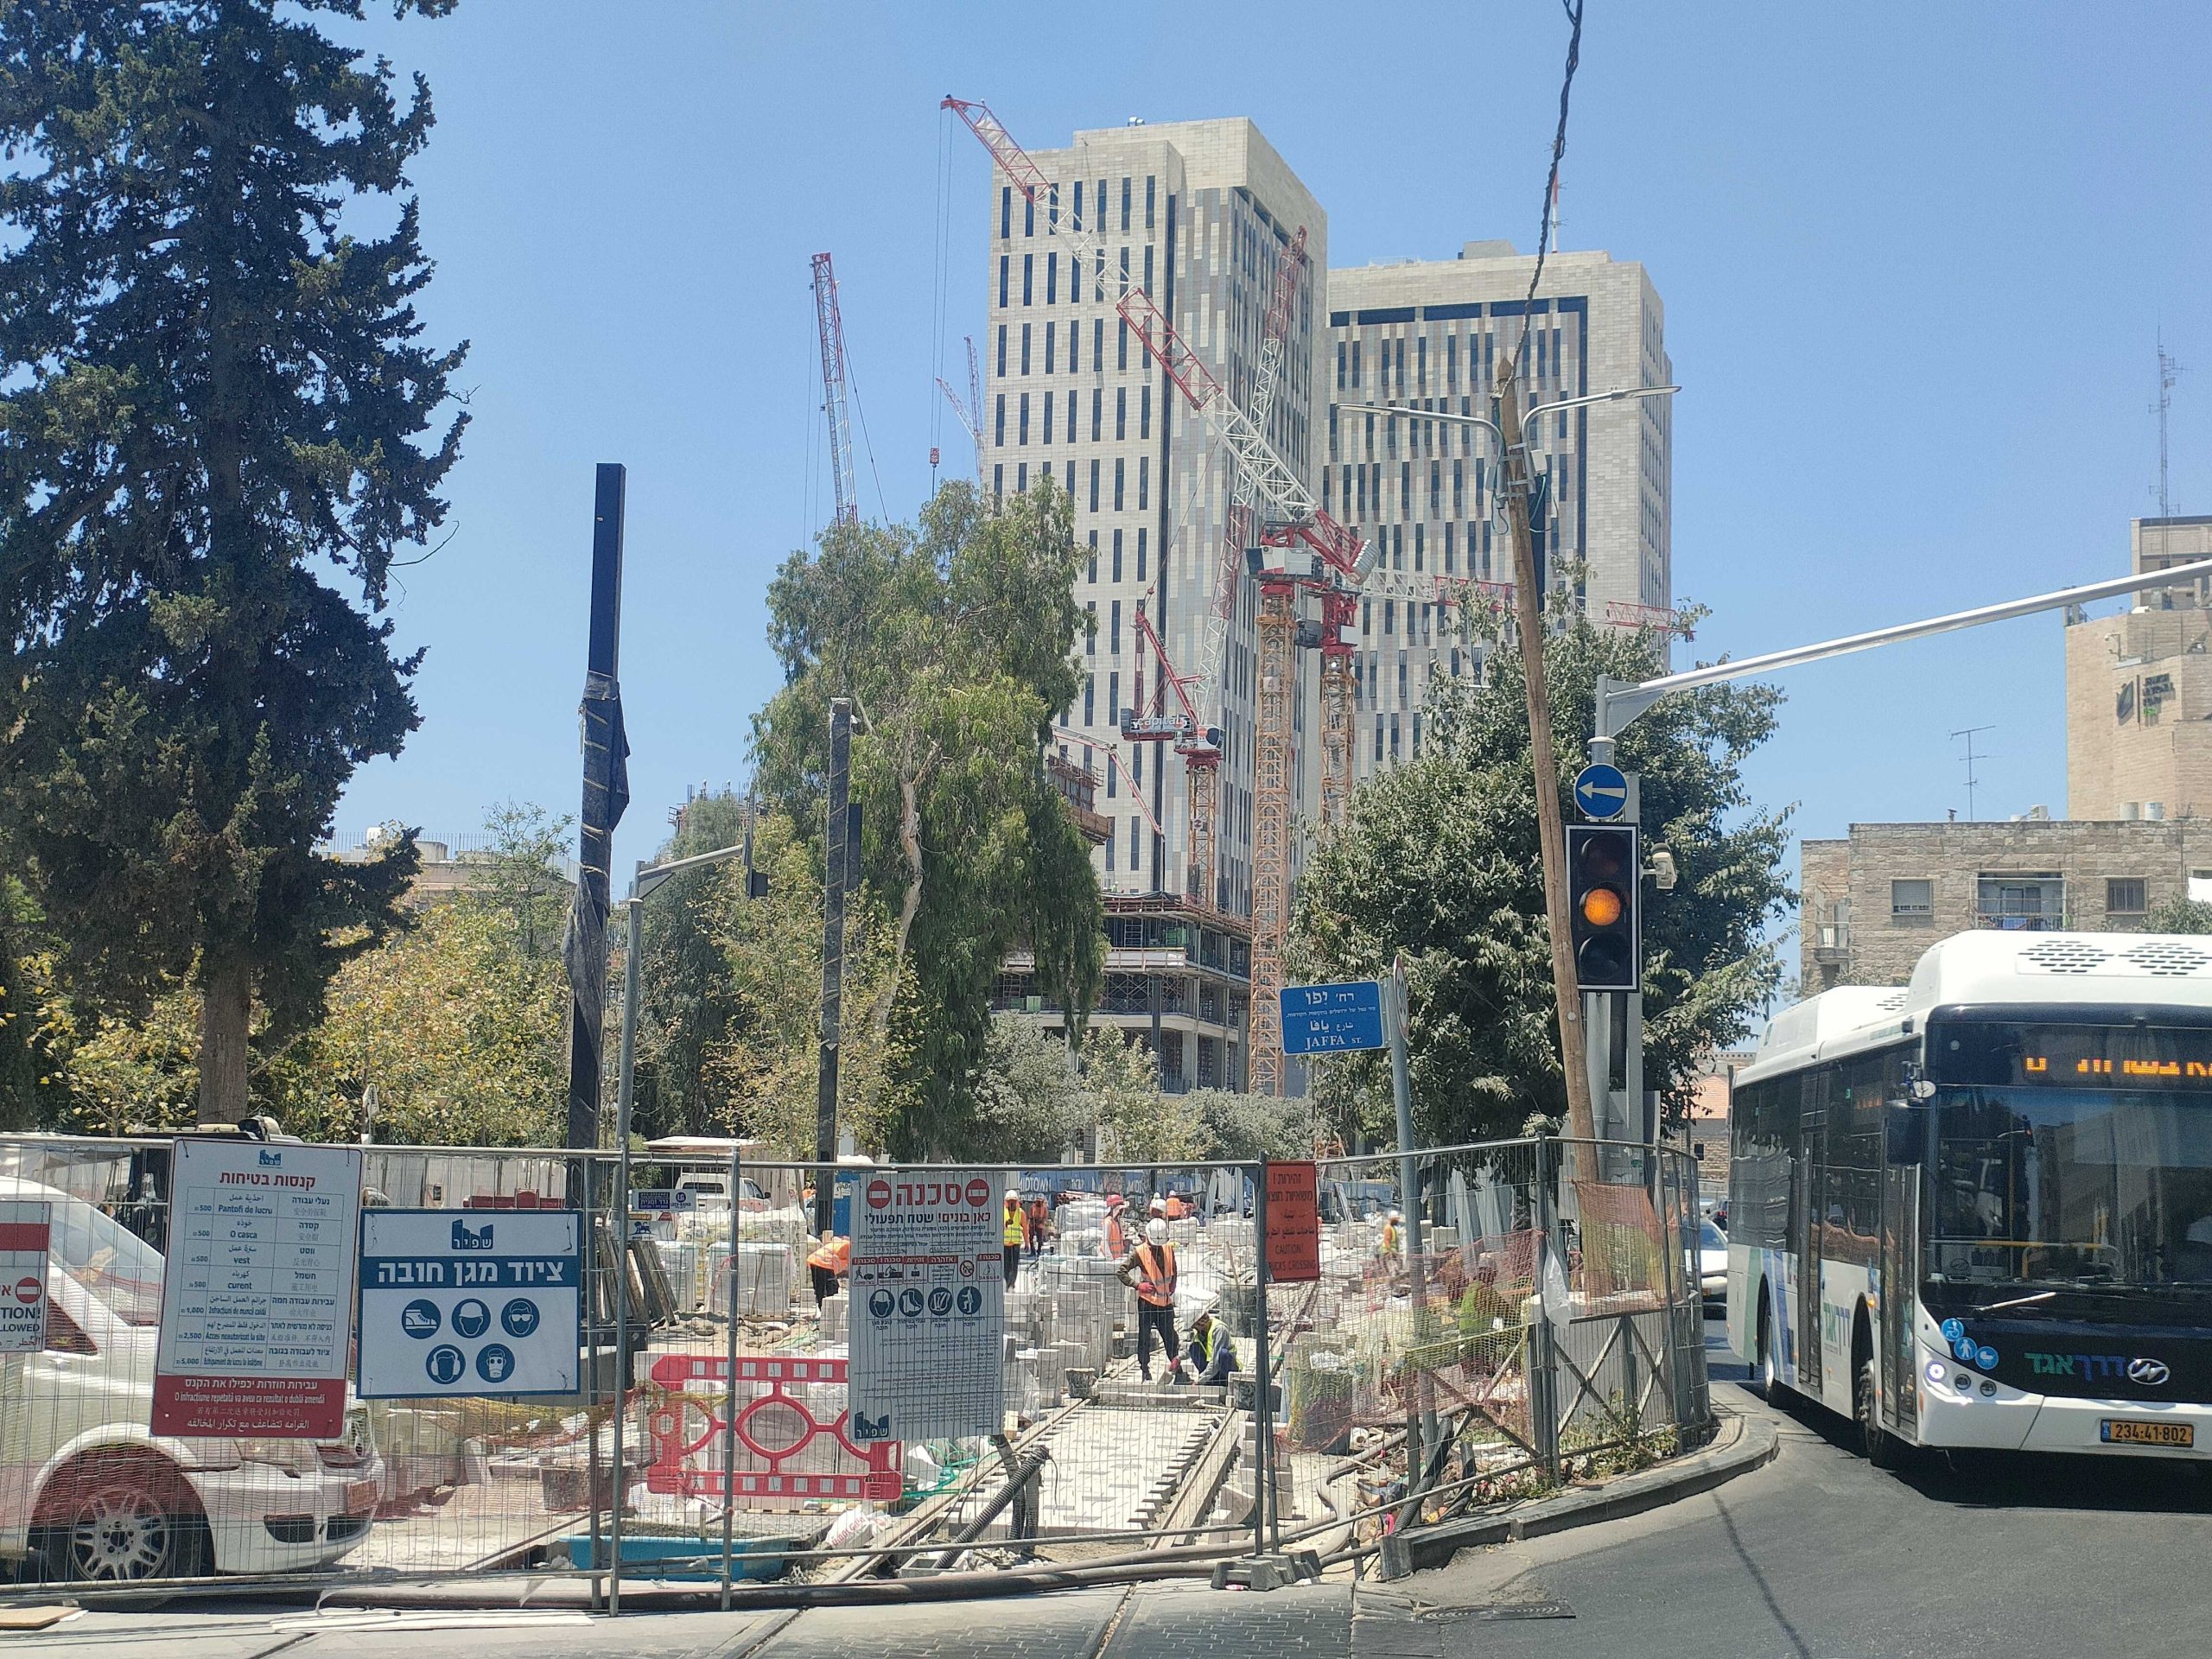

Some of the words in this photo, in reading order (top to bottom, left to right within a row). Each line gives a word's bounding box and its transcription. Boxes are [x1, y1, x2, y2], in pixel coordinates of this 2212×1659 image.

[1138, 714, 1180, 728] capital
[1336, 1022, 1353, 1032] شارع
[1305, 1035, 1345, 1051] JAFFA
[219, 1173, 270, 1185] בטיחות
[274, 1176, 315, 1191] קנסות
[896, 1183, 962, 1206] סכנה
[1286, 1191, 1313, 1201] משאיות
[315, 1197, 330, 1205] נעלי
[864, 1214, 904, 1224] תפעולי
[907, 1214, 933, 1224] שטח
[938, 1213, 969, 1223] בונים!
[974, 1212, 990, 1225] כאן
[299, 1222, 319, 1230] קסדה
[378, 1262, 444, 1283] חובה
[454, 1262, 498, 1287] מגן
[508, 1262, 563, 1281] ציוד
[185, 1378, 210, 1390] הקנס
[229, 1379, 255, 1389] יכפילו
[259, 1380, 286, 1389] חוזרות
[288, 1381, 317, 1389] עבירות
[264, 1395, 283, 1403] rezultat
[238, 1421, 249, 1432] مع
